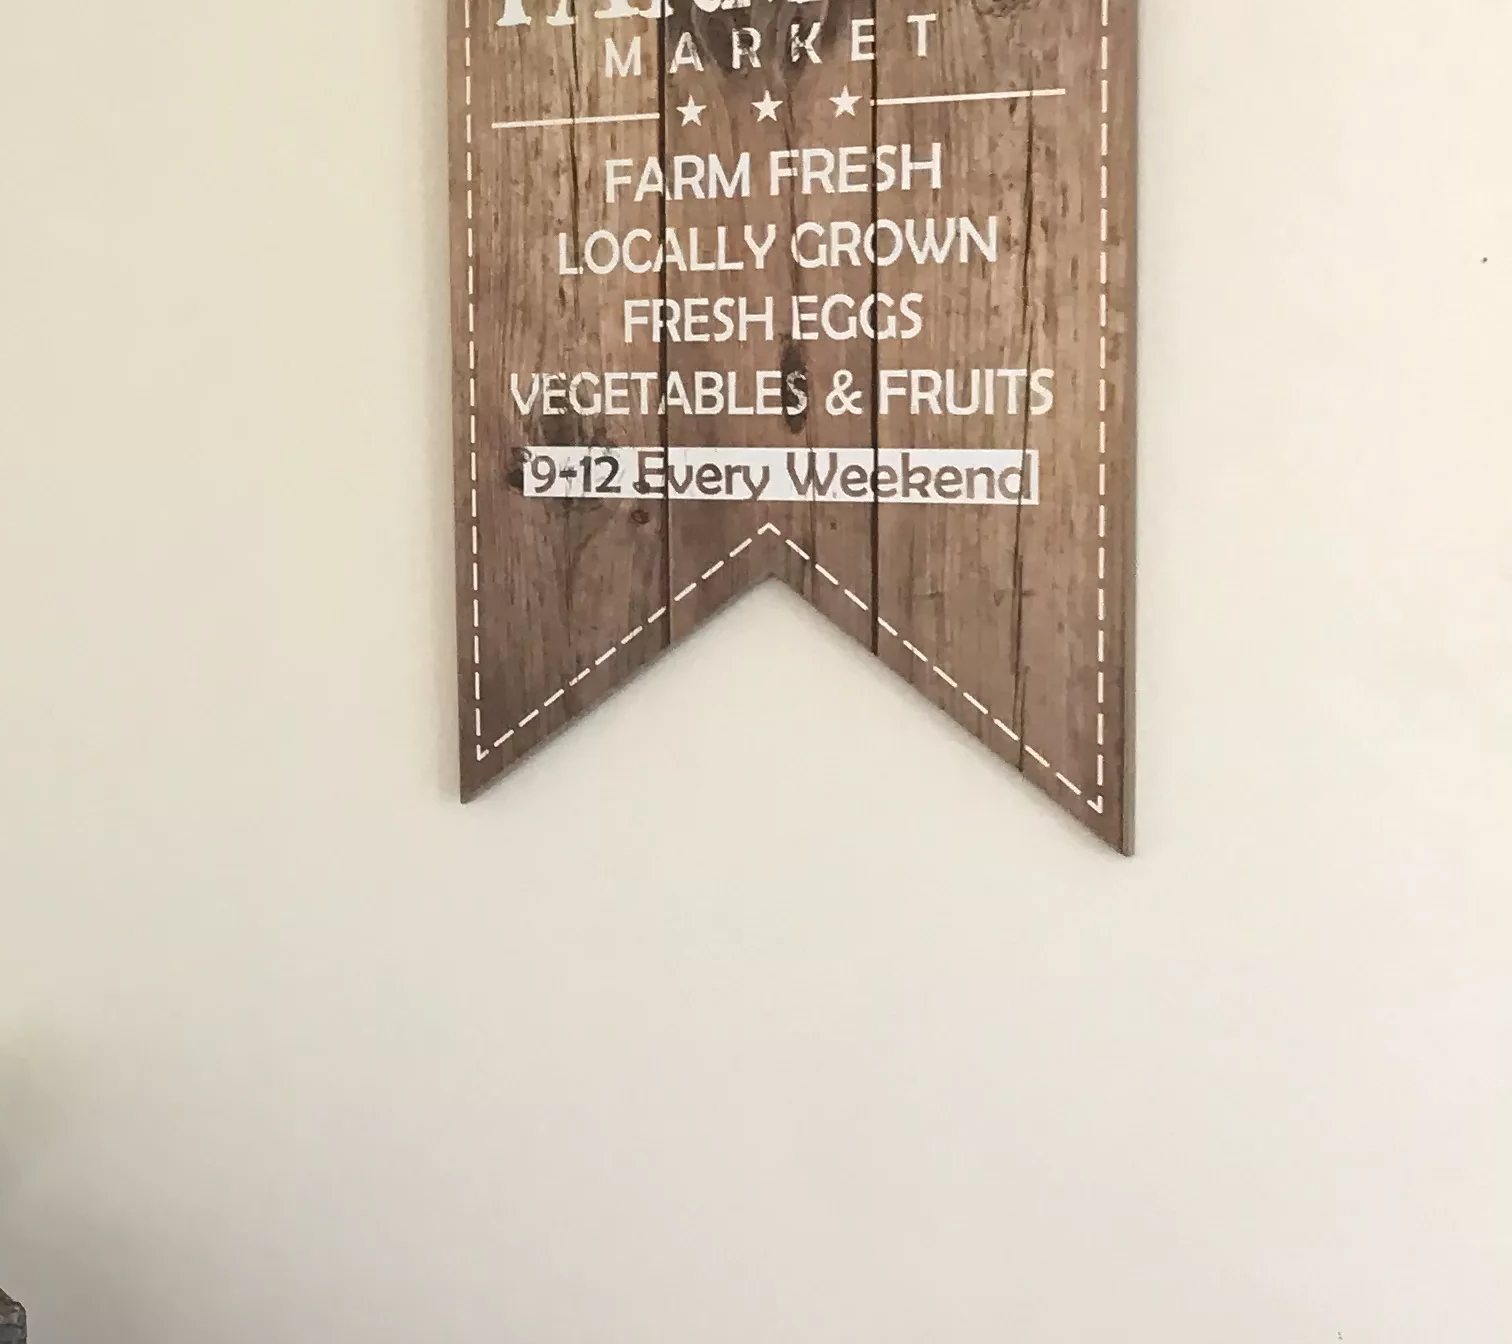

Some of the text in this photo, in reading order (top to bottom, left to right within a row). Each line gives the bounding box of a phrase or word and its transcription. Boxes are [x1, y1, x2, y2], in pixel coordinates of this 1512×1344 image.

[604, 13, 939, 79] MARKET
[603, 142, 942, 204] FARM FRESH
[557, 216, 1000, 277] LOCALLY GROWN
[623, 292, 924, 344] FRESH EGGS
[509, 367, 1055, 418] VEGETABLES & FRUITS
[530, 451, 1032, 502] 9-12 Every Weekend
